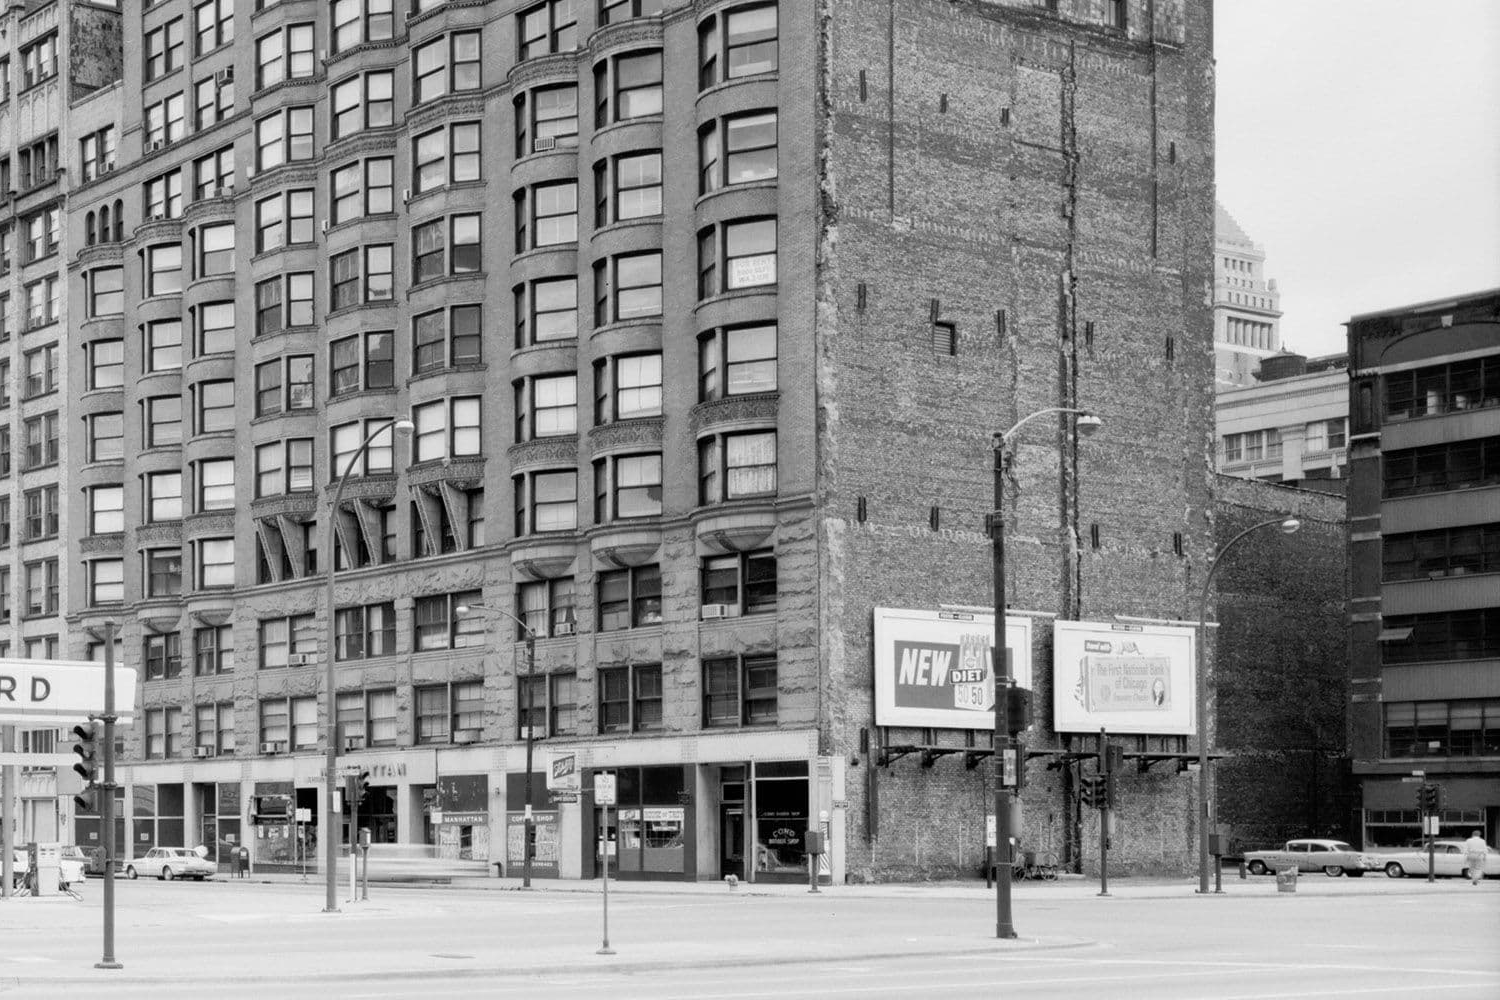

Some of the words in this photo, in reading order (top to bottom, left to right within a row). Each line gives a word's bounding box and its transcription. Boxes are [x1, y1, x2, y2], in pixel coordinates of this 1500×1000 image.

[899, 647, 952, 687] NEW
[1108, 663, 1122, 676] First
[1123, 663, 1148, 676] National
[1149, 663, 1165, 676] Bank
[952, 669, 982, 683] DIET
[1122, 678, 1148, 691] Chicago
[971, 686, 984, 706] 50
[444, 815, 483, 823] MANHATTAN
